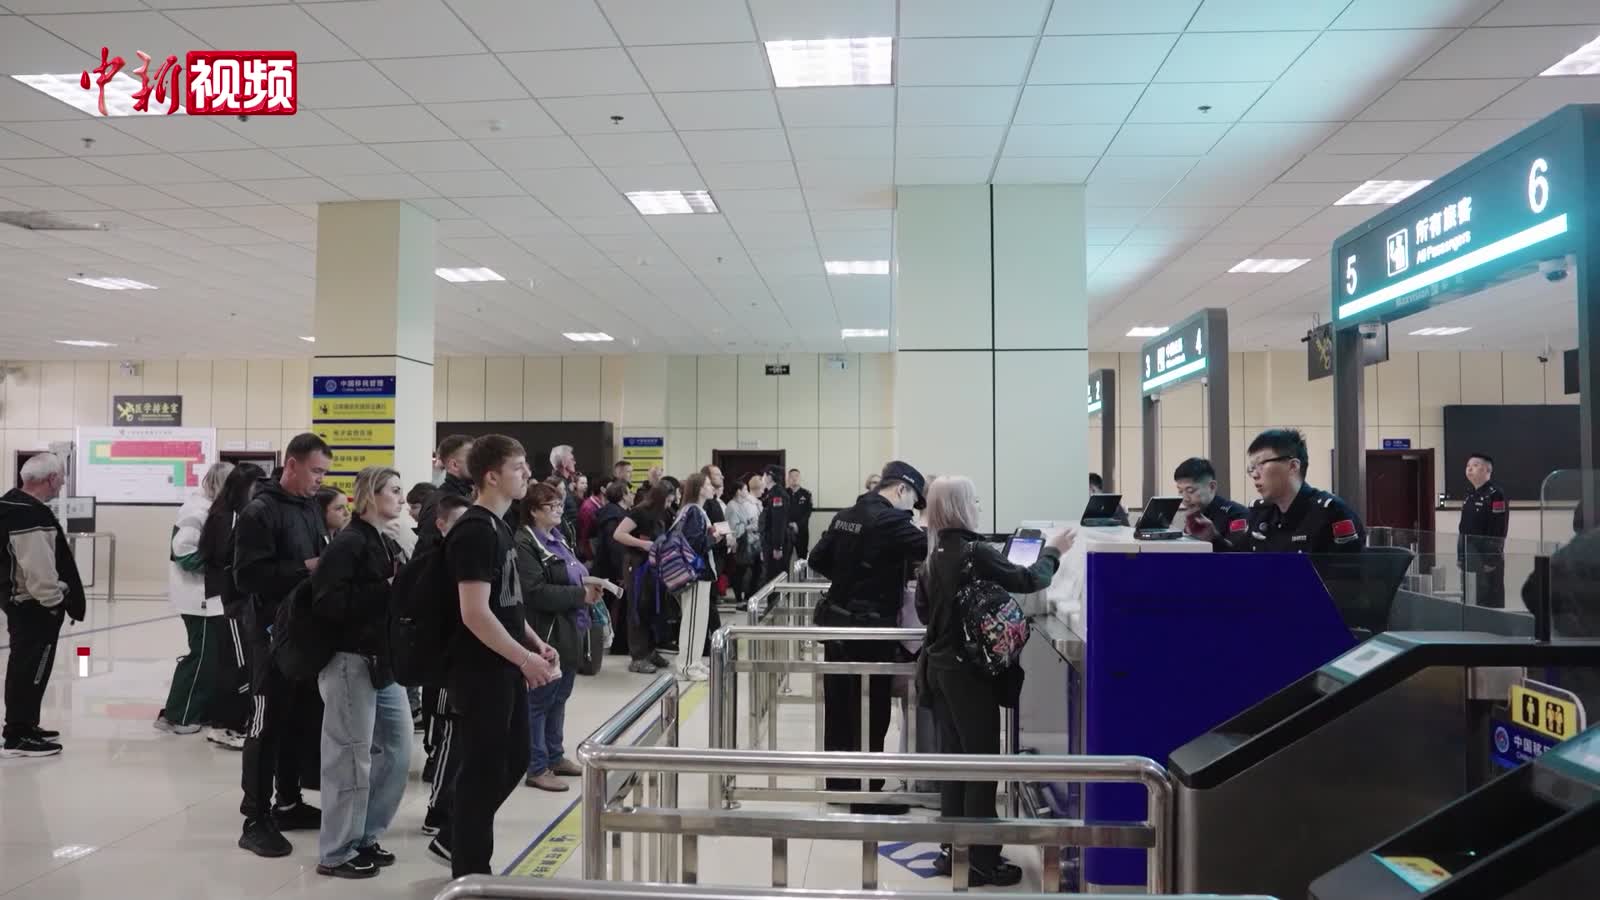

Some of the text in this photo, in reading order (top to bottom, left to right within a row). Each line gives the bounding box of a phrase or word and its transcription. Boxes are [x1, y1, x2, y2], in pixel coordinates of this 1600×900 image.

[1527, 157, 1550, 214] 6
[1416, 197, 1472, 245] 所有旅客
[1427, 231, 1471, 258] Passengers
[1345, 254, 1358, 295] 5
[1195, 328, 1202, 354] 4
[1145, 354, 1151, 378] 3
